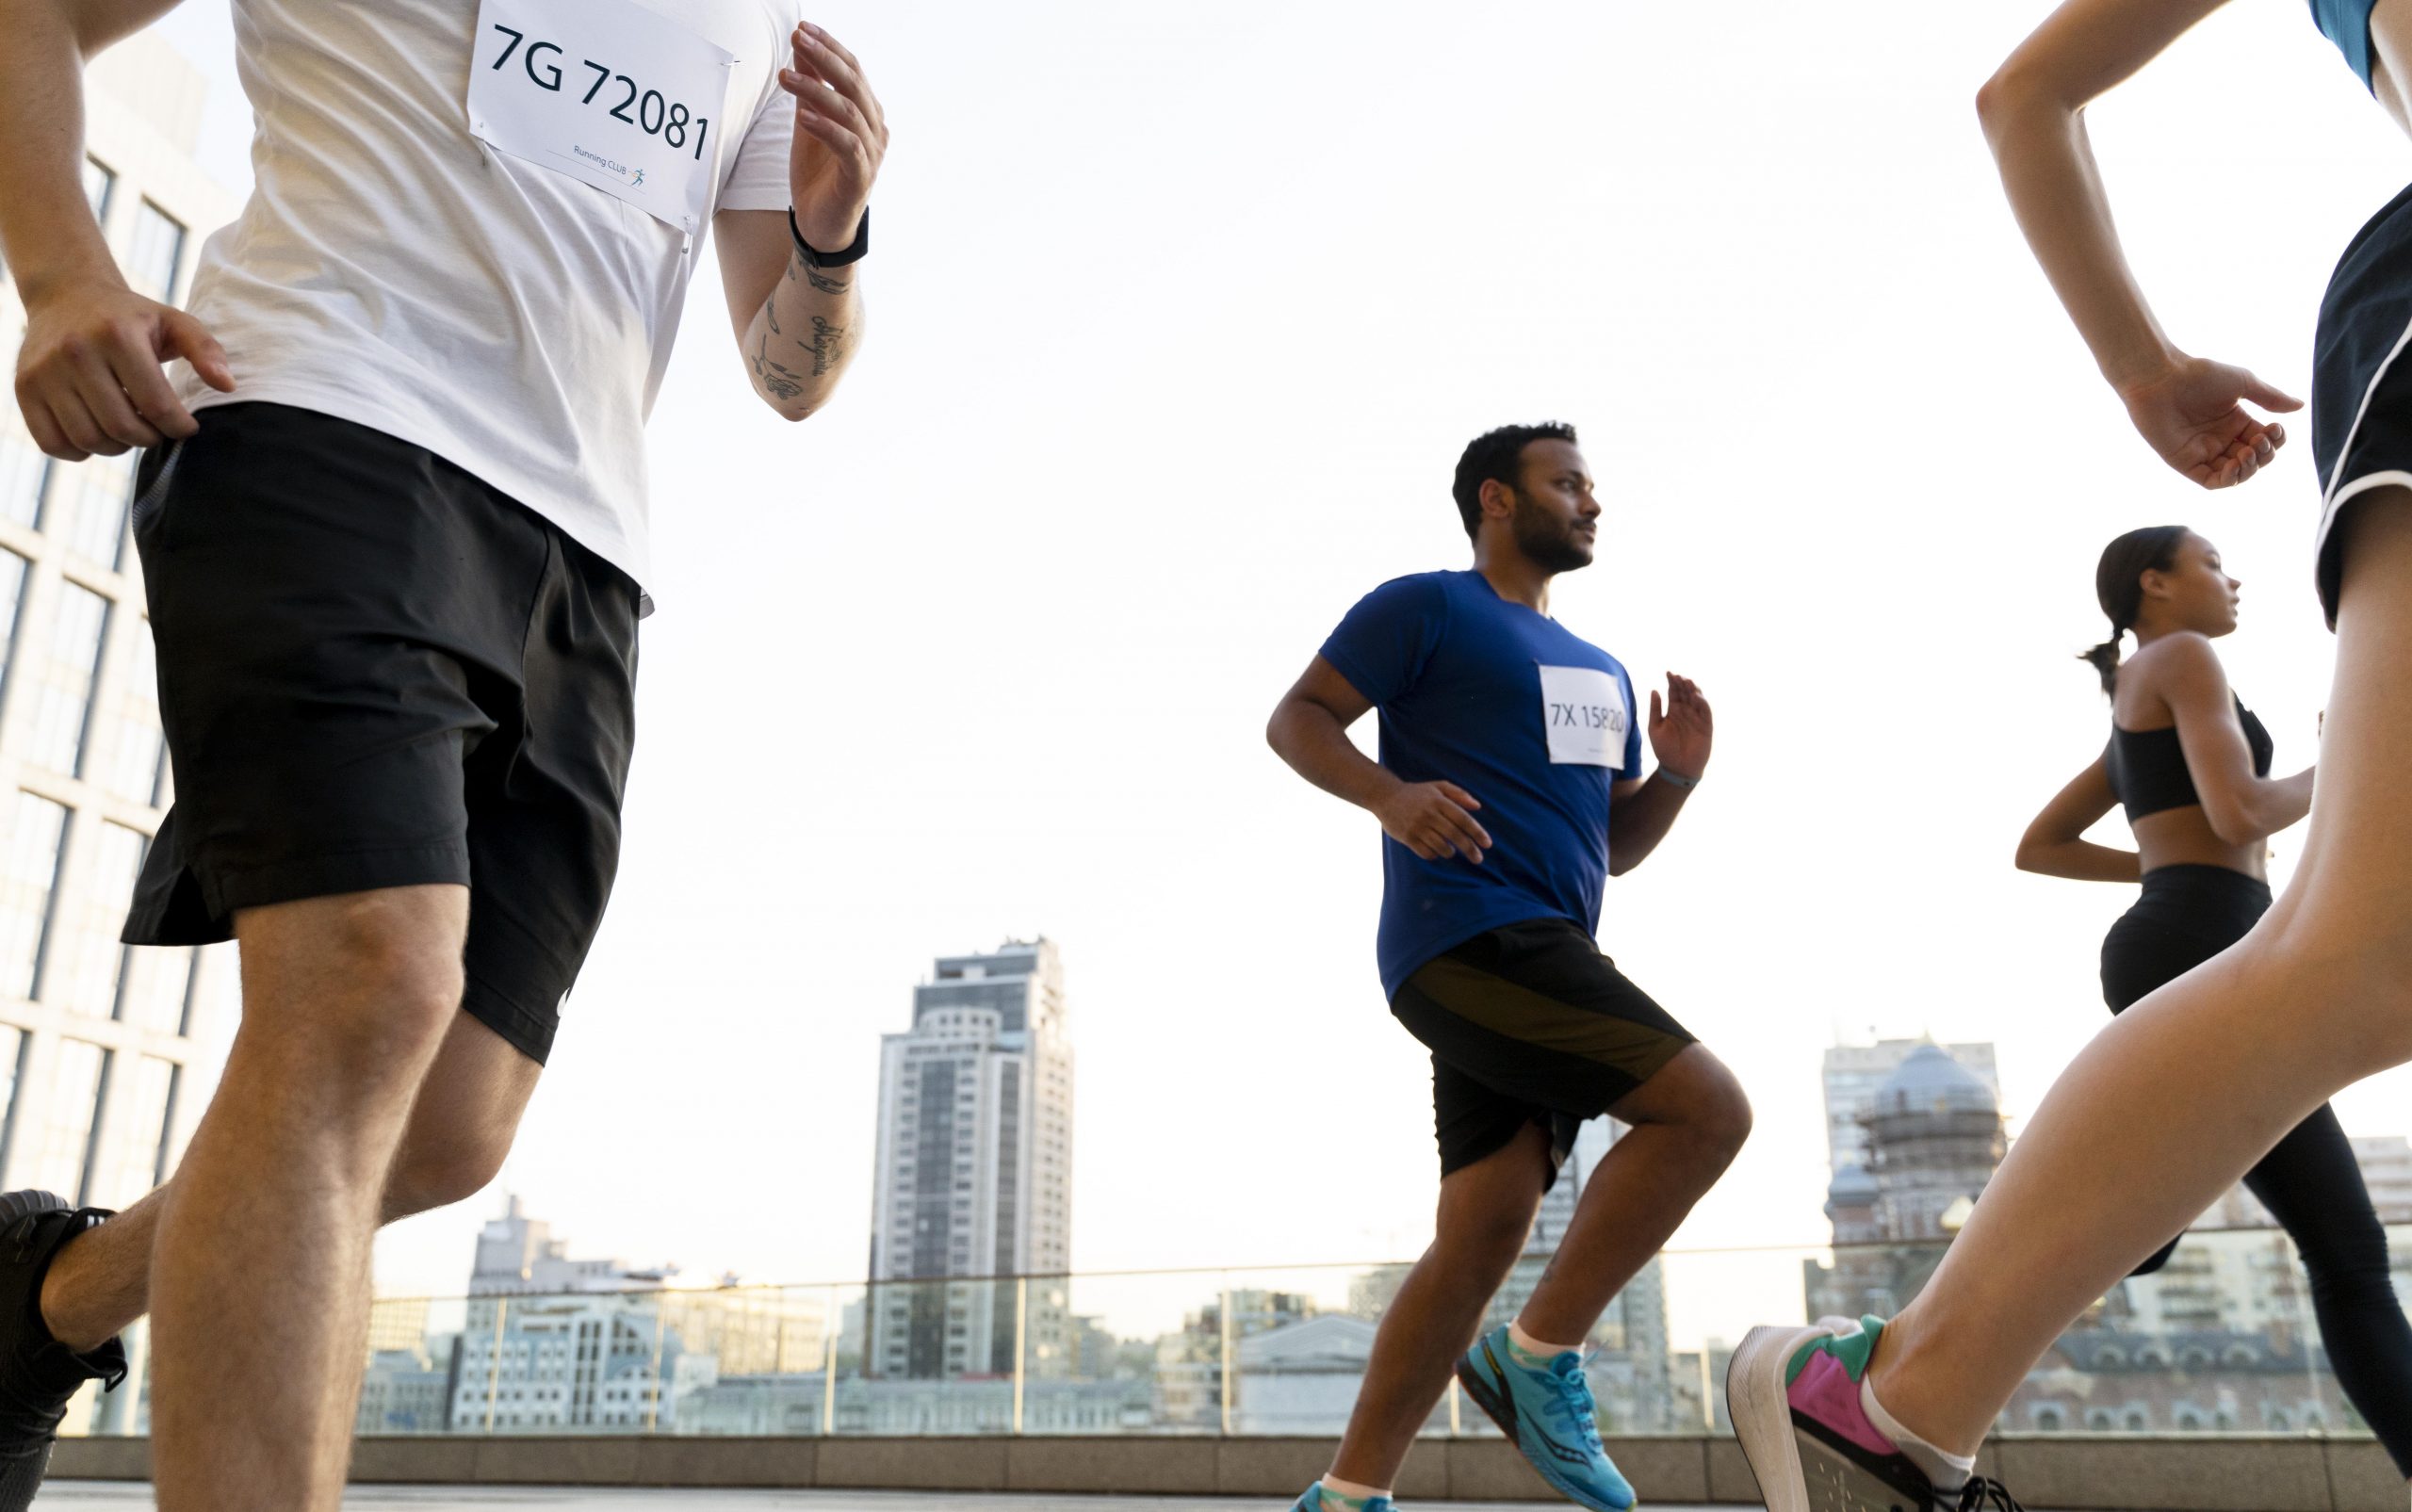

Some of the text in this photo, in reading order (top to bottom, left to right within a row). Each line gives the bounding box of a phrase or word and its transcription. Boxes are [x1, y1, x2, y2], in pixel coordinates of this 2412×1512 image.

[492, 24, 709, 161] 7G 72081
[574, 145, 627, 175] Running CLUB
[1550, 703, 1577, 727] 7X
